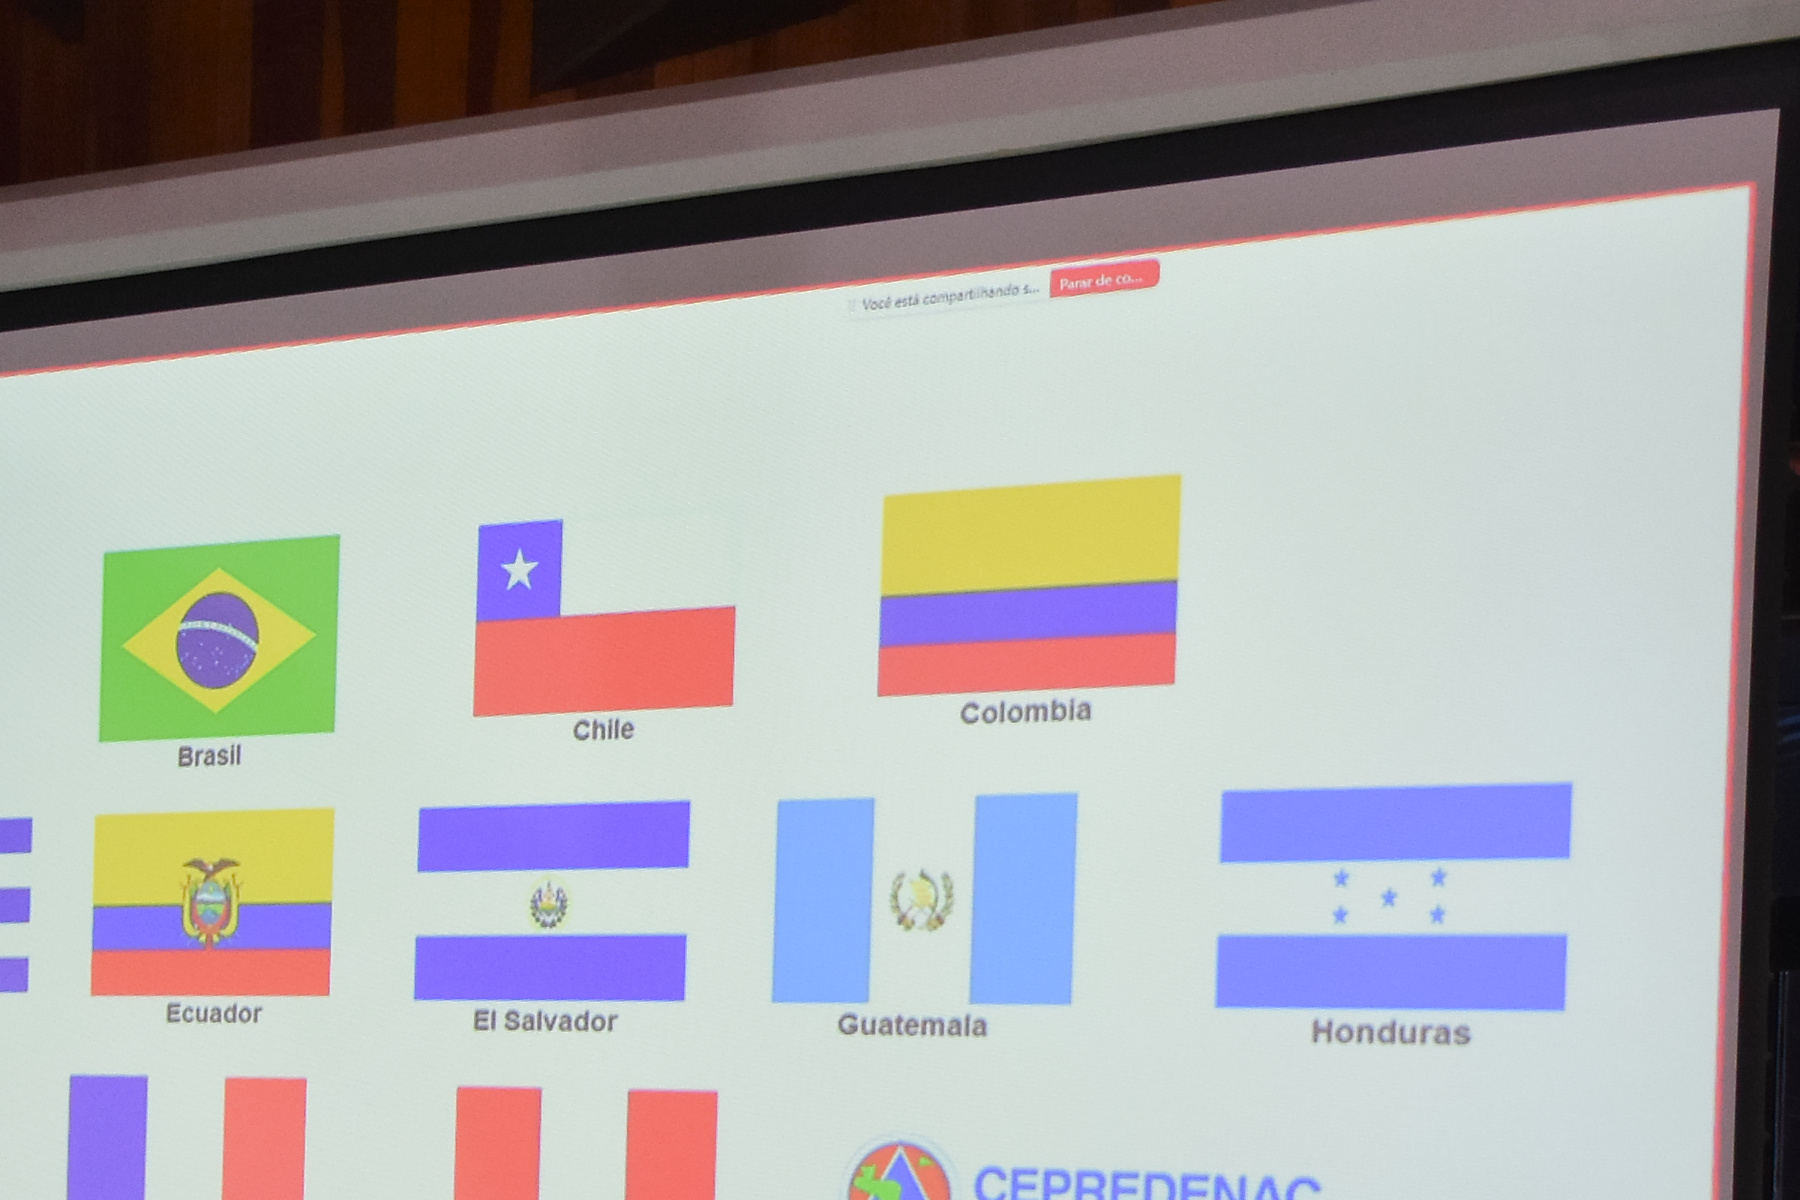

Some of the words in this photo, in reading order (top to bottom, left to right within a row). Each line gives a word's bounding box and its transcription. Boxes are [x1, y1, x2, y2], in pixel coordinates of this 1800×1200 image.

[1060, 277, 1093, 291] Parar
[1095, 273, 1112, 286] de
[862, 296, 891, 311] Você
[894, 293, 919, 308] está
[922, 283, 1020, 305] compartilhando
[960, 697, 1093, 726] Colombia
[573, 717, 635, 742] Chile
[178, 744, 242, 769] Brasil
[166, 1001, 263, 1026] Ecuador
[473, 1009, 497, 1032] El
[504, 1008, 619, 1034] Salvador
[837, 1012, 988, 1039] Guatemala
[1311, 1018, 1471, 1046] Honduras
